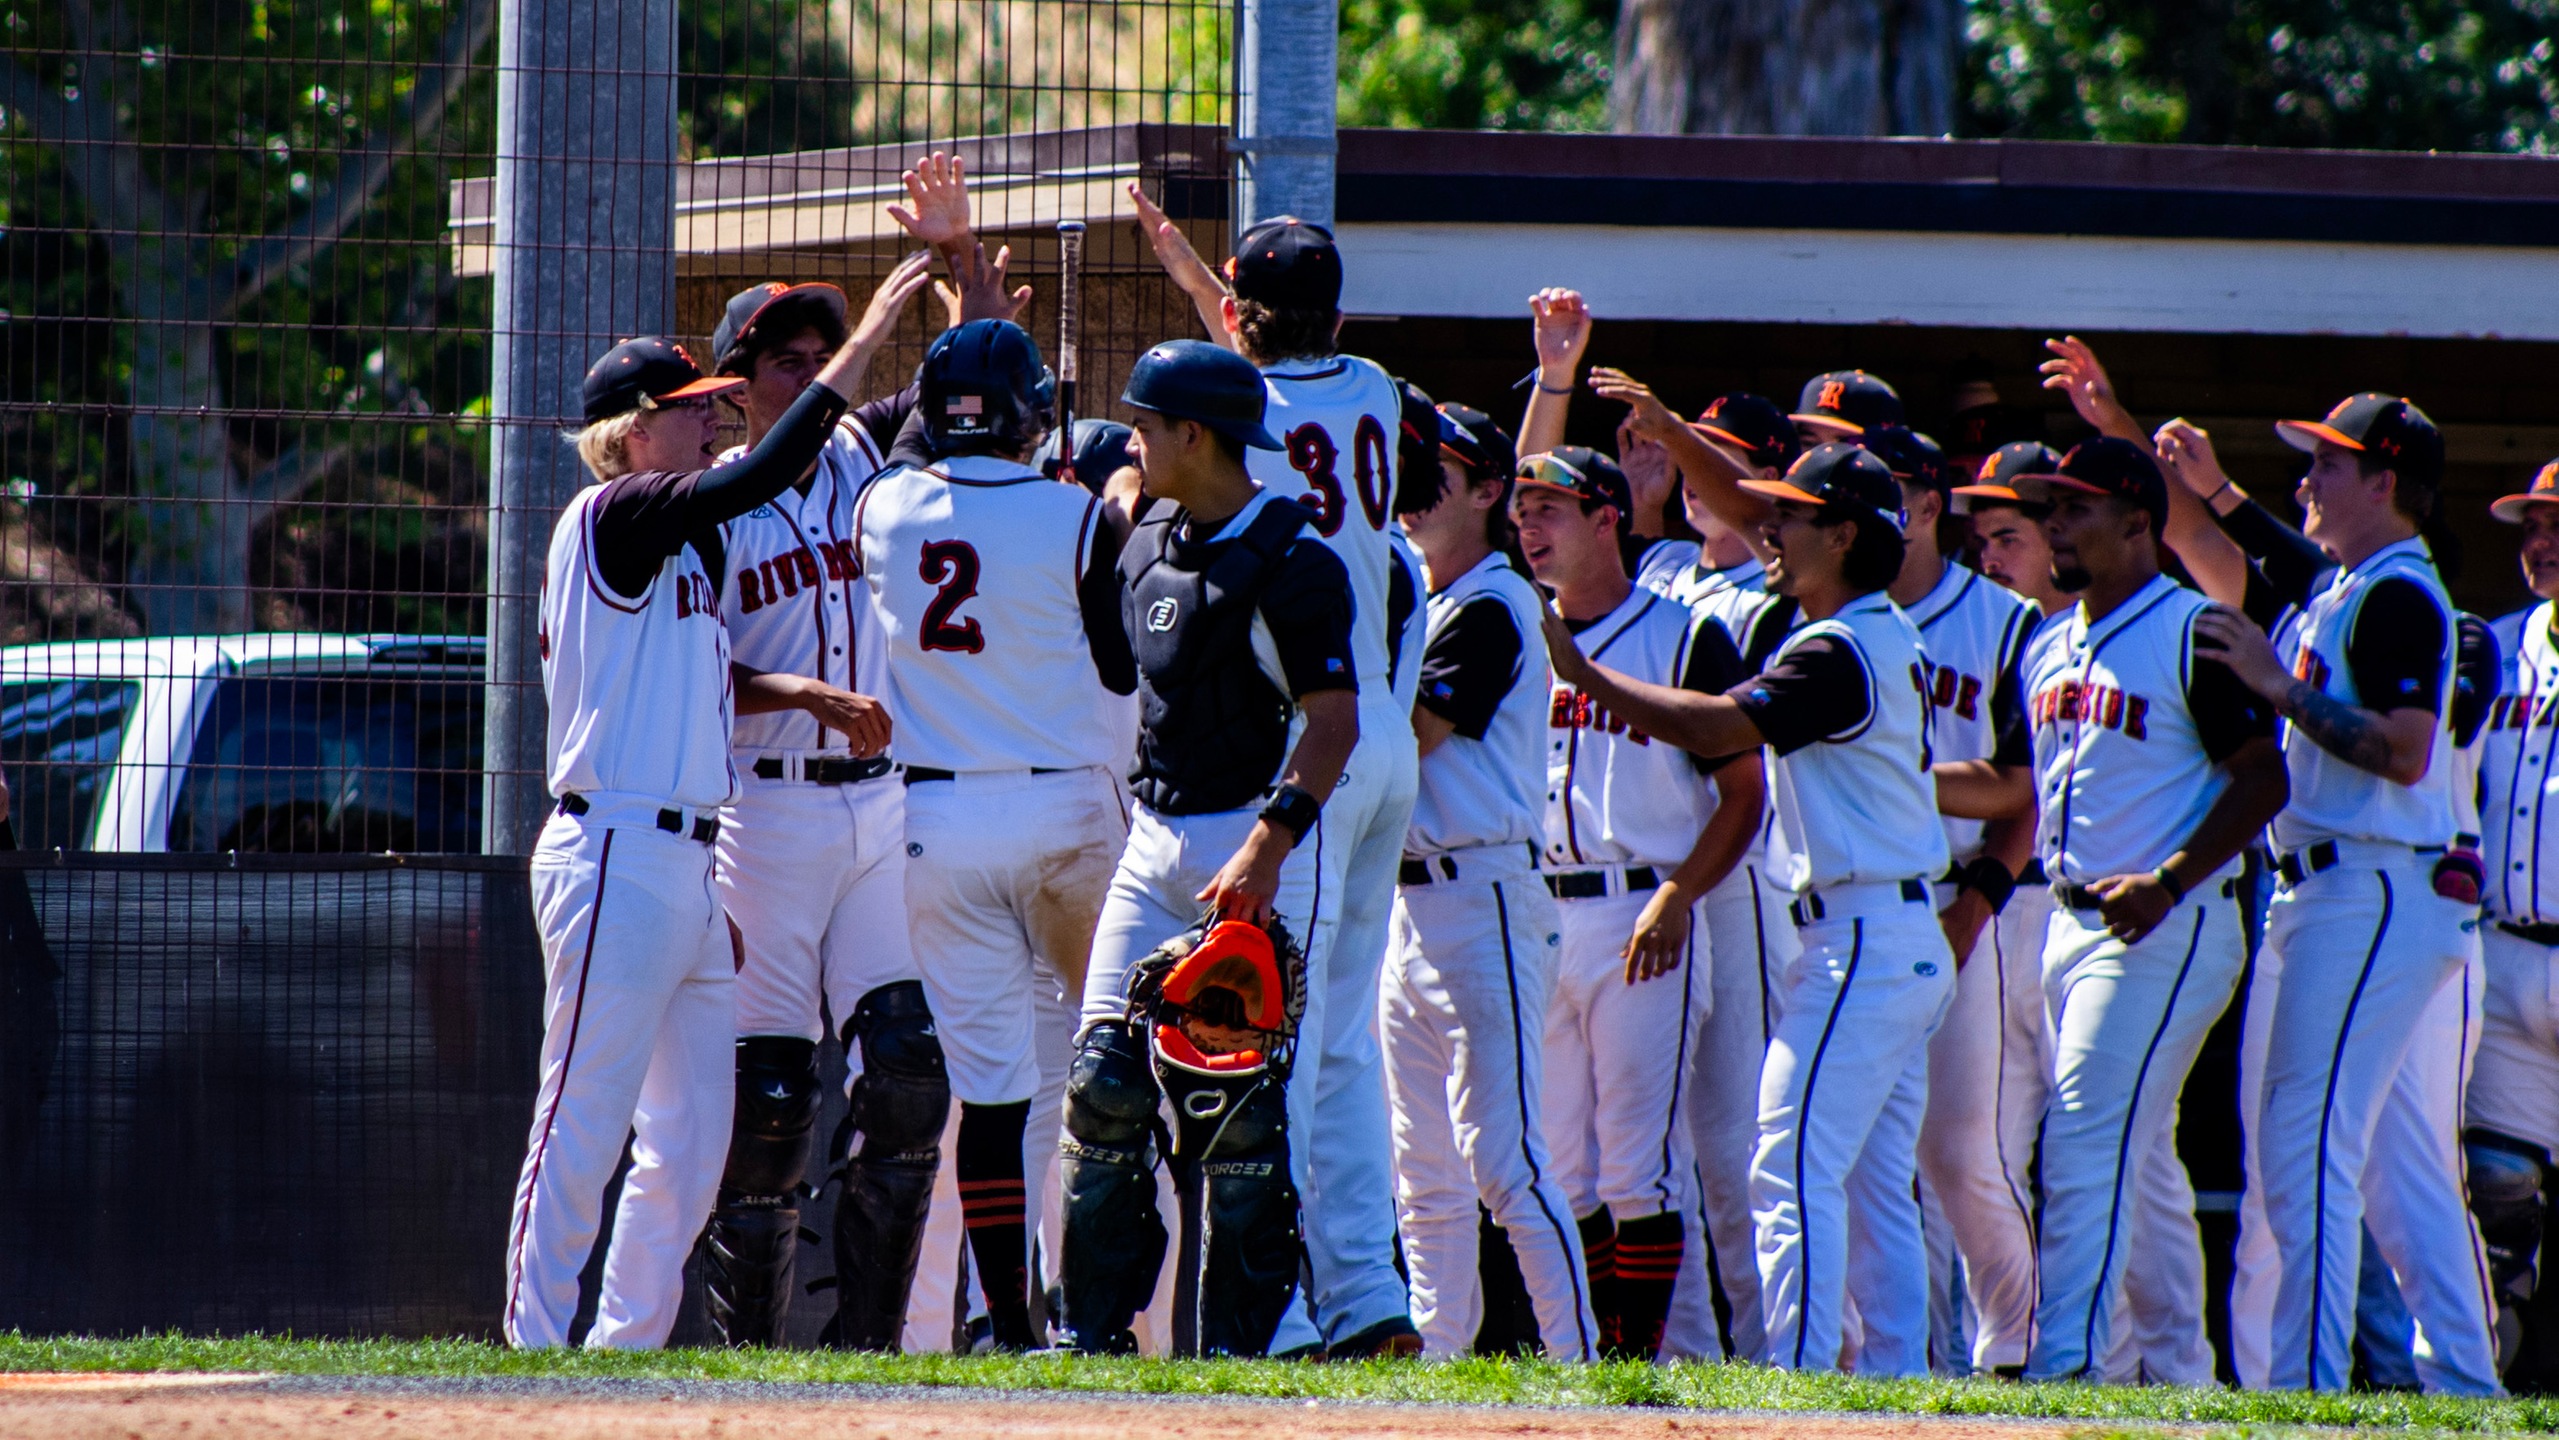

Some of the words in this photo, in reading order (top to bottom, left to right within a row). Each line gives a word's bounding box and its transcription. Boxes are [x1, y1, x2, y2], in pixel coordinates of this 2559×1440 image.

[1817, 381, 1845, 410] R
[1285, 413, 1391, 537] 30
[919, 538, 985, 654] 2
